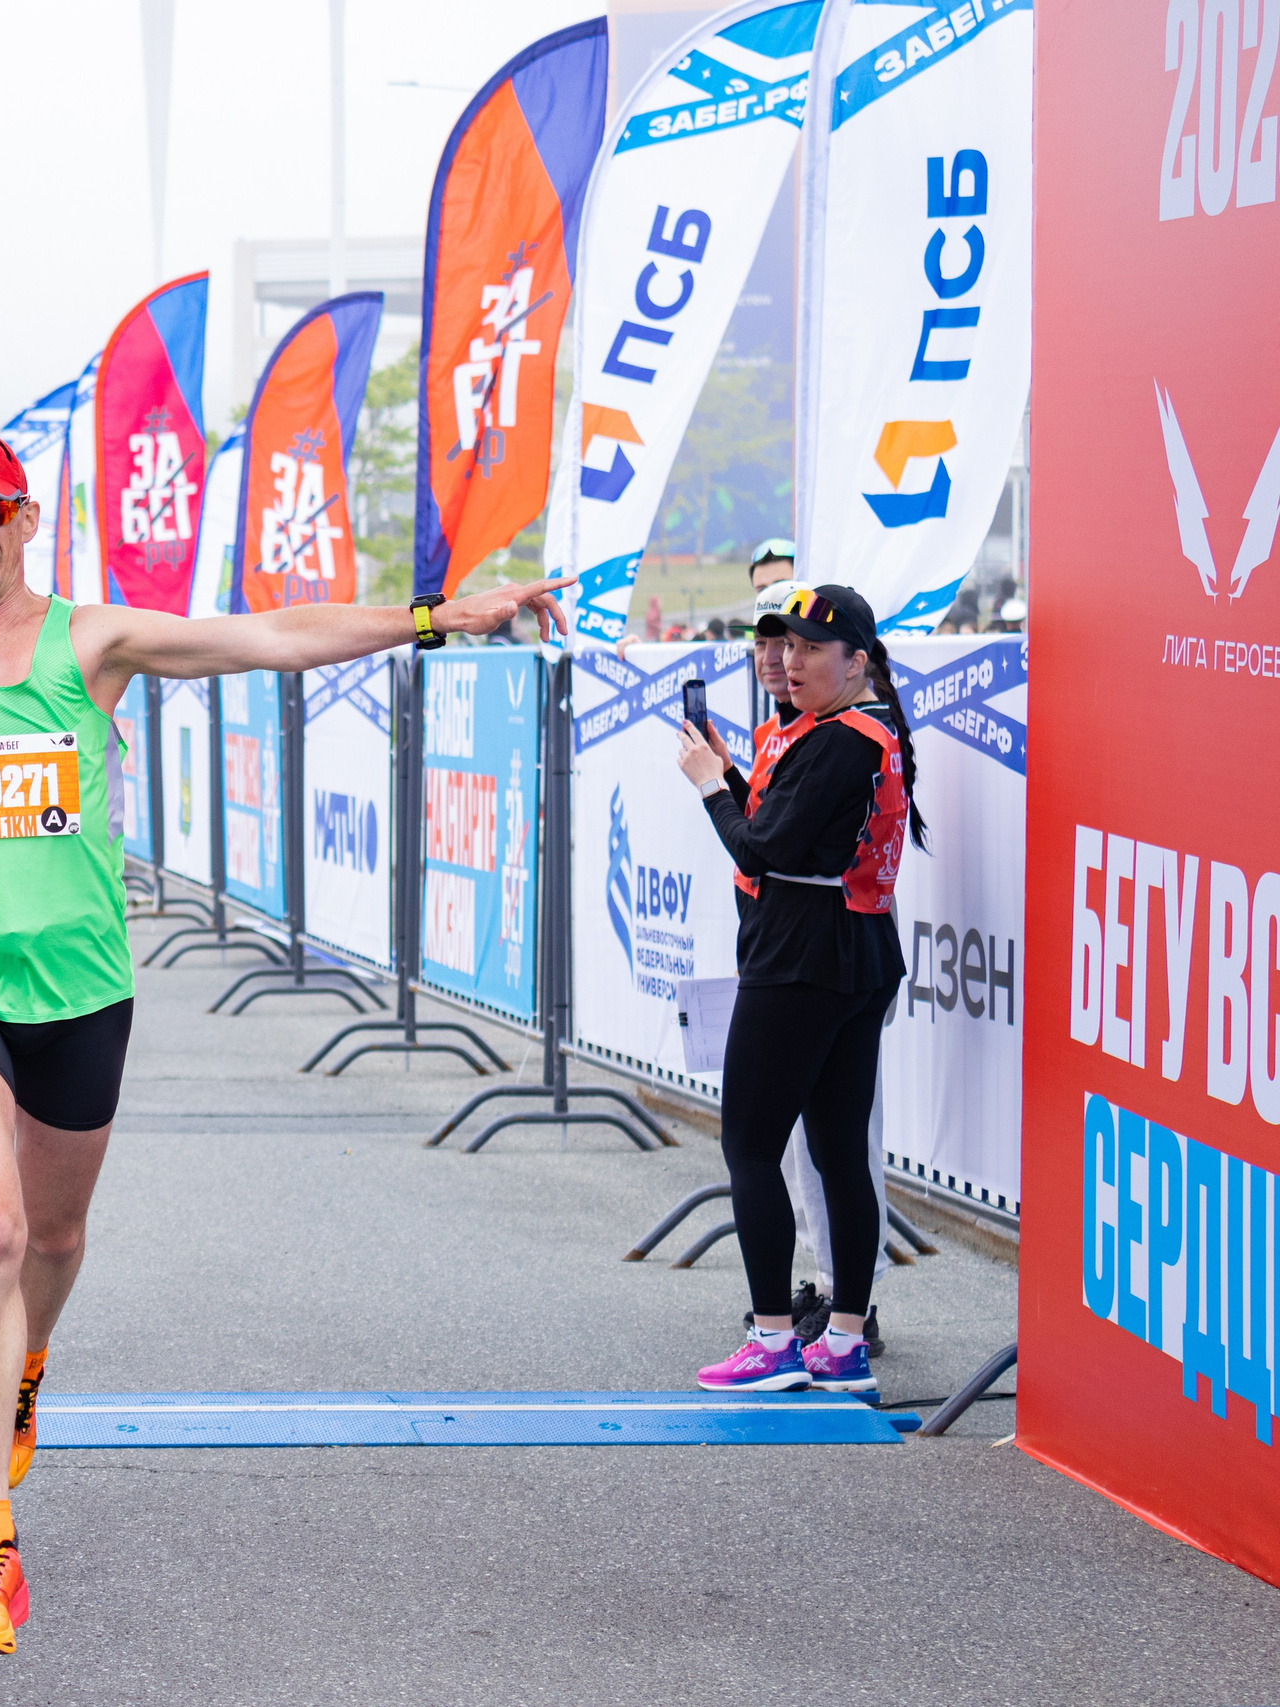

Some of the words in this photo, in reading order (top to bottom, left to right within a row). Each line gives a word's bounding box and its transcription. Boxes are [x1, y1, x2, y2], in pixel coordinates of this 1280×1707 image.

[648, 78, 810, 139] ЗАБЕГ.РФ
[601, 204, 712, 384] ПСБ
[909, 148, 989, 382] ПСБ
[129, 431, 188, 491] ЗА
[270, 451, 331, 530] ЗА
[121, 482, 198, 545] БЕГ
[260, 507, 344, 582] БЕГ
[1162, 634, 1207, 670] ЛИГА
[642, 661, 699, 710] ЗАБЕГ.РФ
[913, 658, 994, 720] ЗАБЕГ.РФ
[580, 699, 630, 746] ЗАБЕГ.РФ
[636, 865, 692, 924] ДВФУ
[636, 925, 695, 951] ДАЛЬНЕВОСТОЧНЫЙ
[637, 945, 695, 978] ФЕДЕРАЛЬНЫЙ
[1069, 824, 1200, 1083] БЕГУ
[908, 920, 1014, 1026] дзен
[1083, 1093, 1280, 1447] СЕРДЦ
